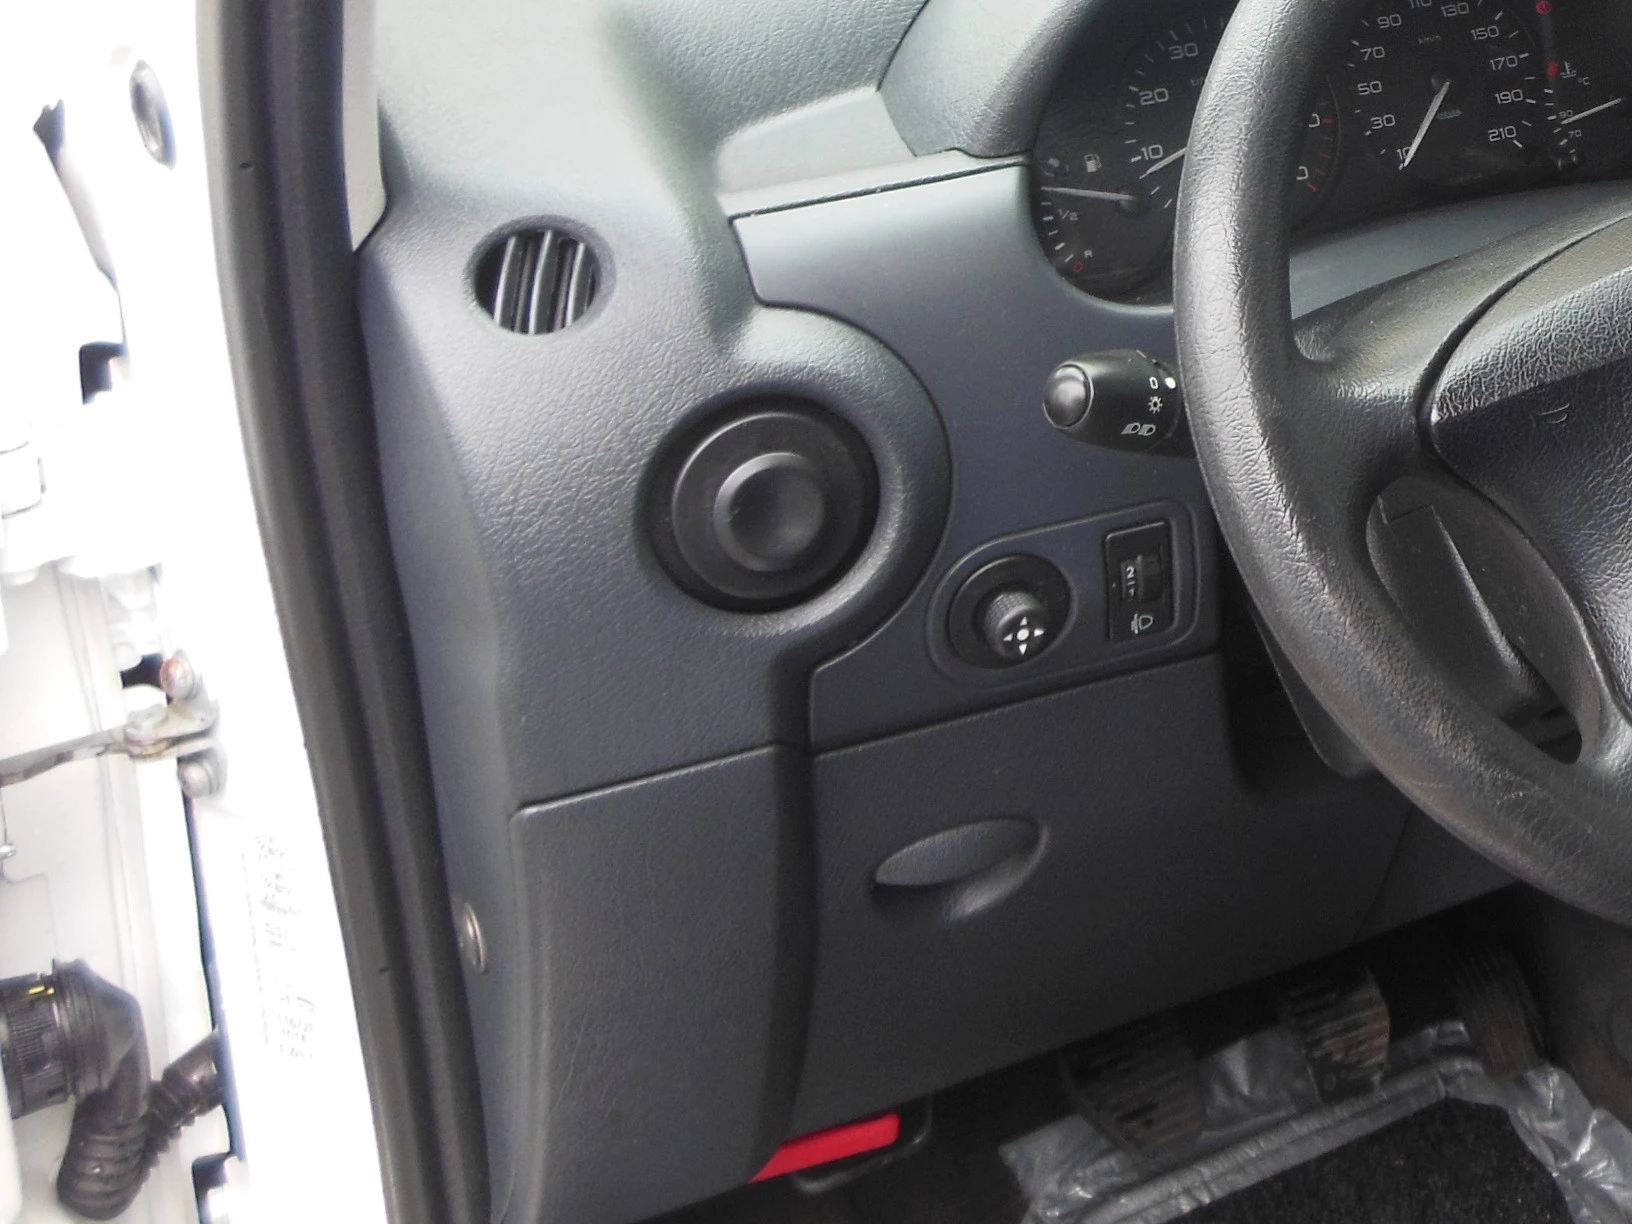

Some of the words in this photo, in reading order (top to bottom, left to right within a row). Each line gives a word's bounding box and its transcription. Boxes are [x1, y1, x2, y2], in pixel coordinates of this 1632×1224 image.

[1441, 2, 1469, 17] 130
[1377, 14, 1402, 29] 90
[1470, 25, 1500, 41] 150
[1168, 43, 1198, 60] 30
[1360, 46, 1385, 61] 70
[1489, 55, 1519, 72] 170
[1357, 81, 1382, 96] 50
[1139, 88, 1168, 106] 20
[1494, 89, 1523, 105] 190
[1370, 114, 1396, 129] 30
[1488, 126, 1517, 142] 210
[1568, 129, 1582, 139] 70
[1140, 144, 1163, 161] 10
[1126, 565, 1135, 579] 2
